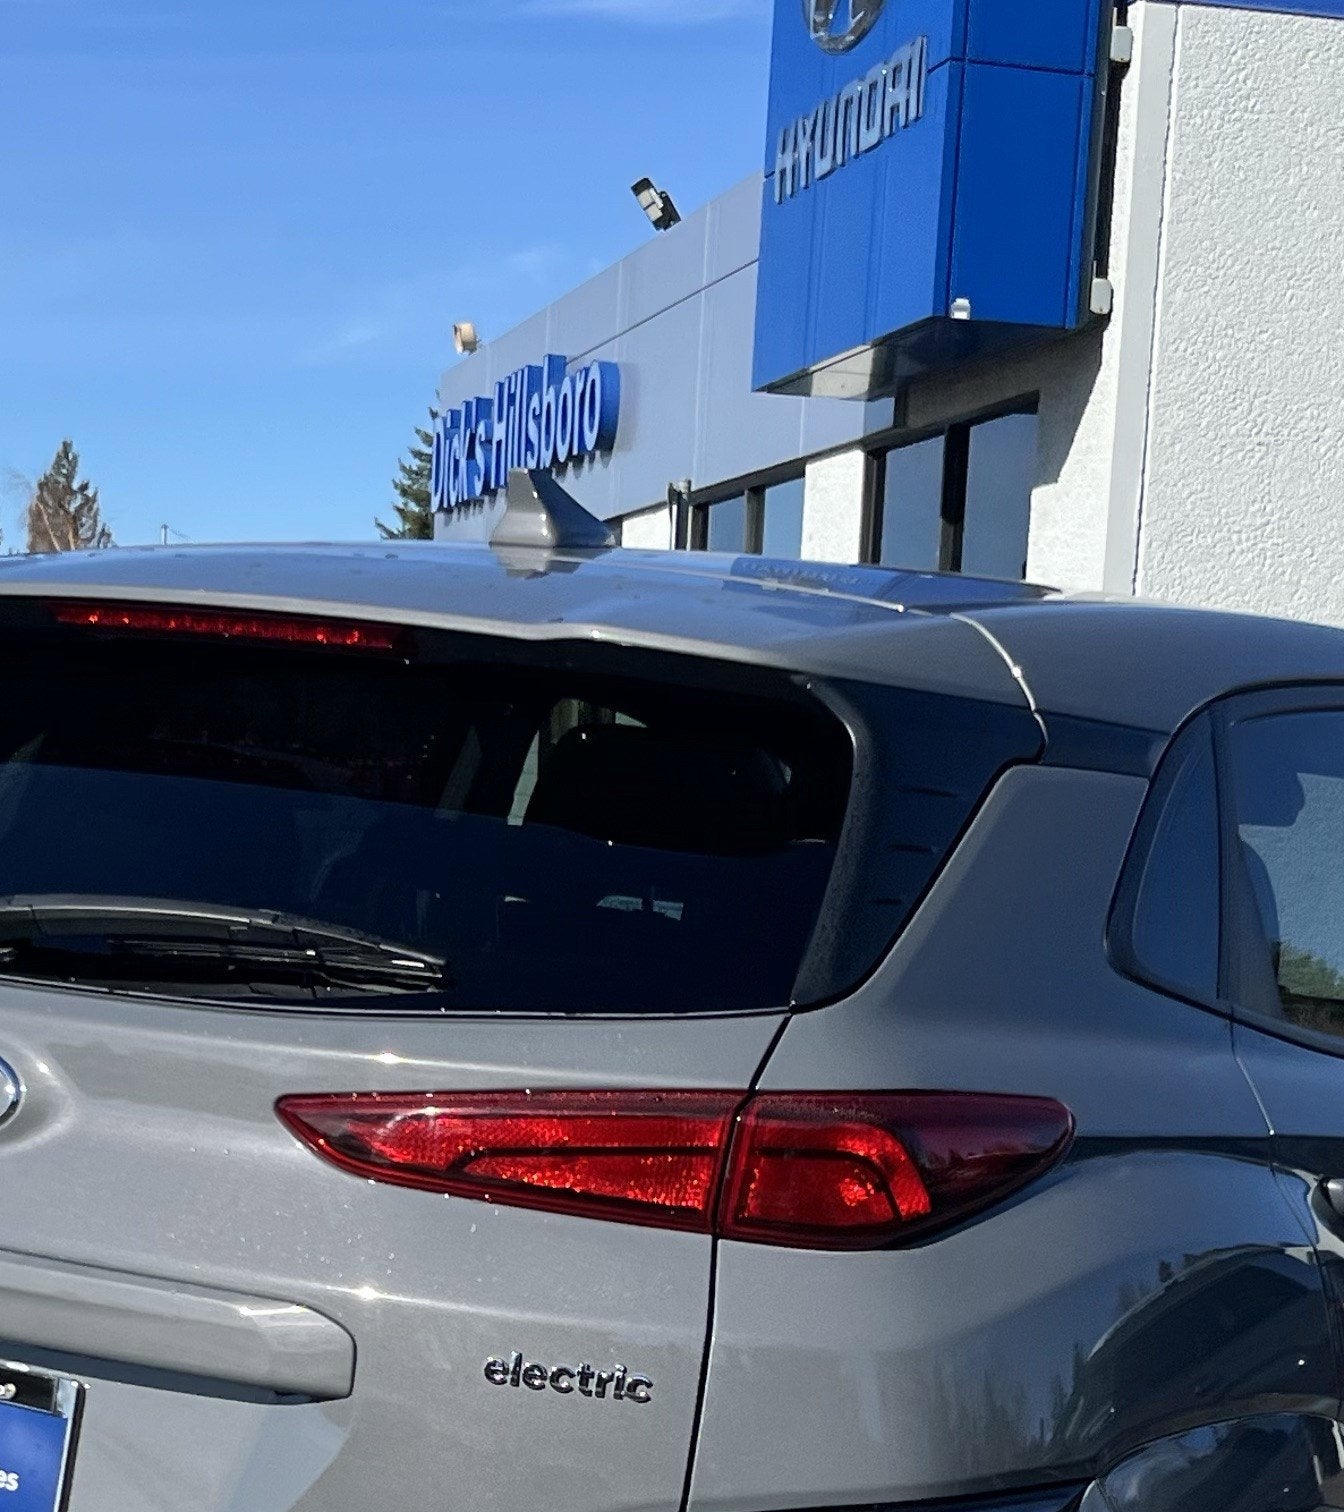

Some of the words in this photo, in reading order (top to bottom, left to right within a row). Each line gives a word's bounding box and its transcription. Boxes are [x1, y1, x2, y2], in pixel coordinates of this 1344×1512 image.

[774, 34, 928, 204] HYUNDAI
[430, 397, 493, 513] Dick's
[490, 354, 610, 489] Hillsboro
[484, 1350, 653, 1403] electric
